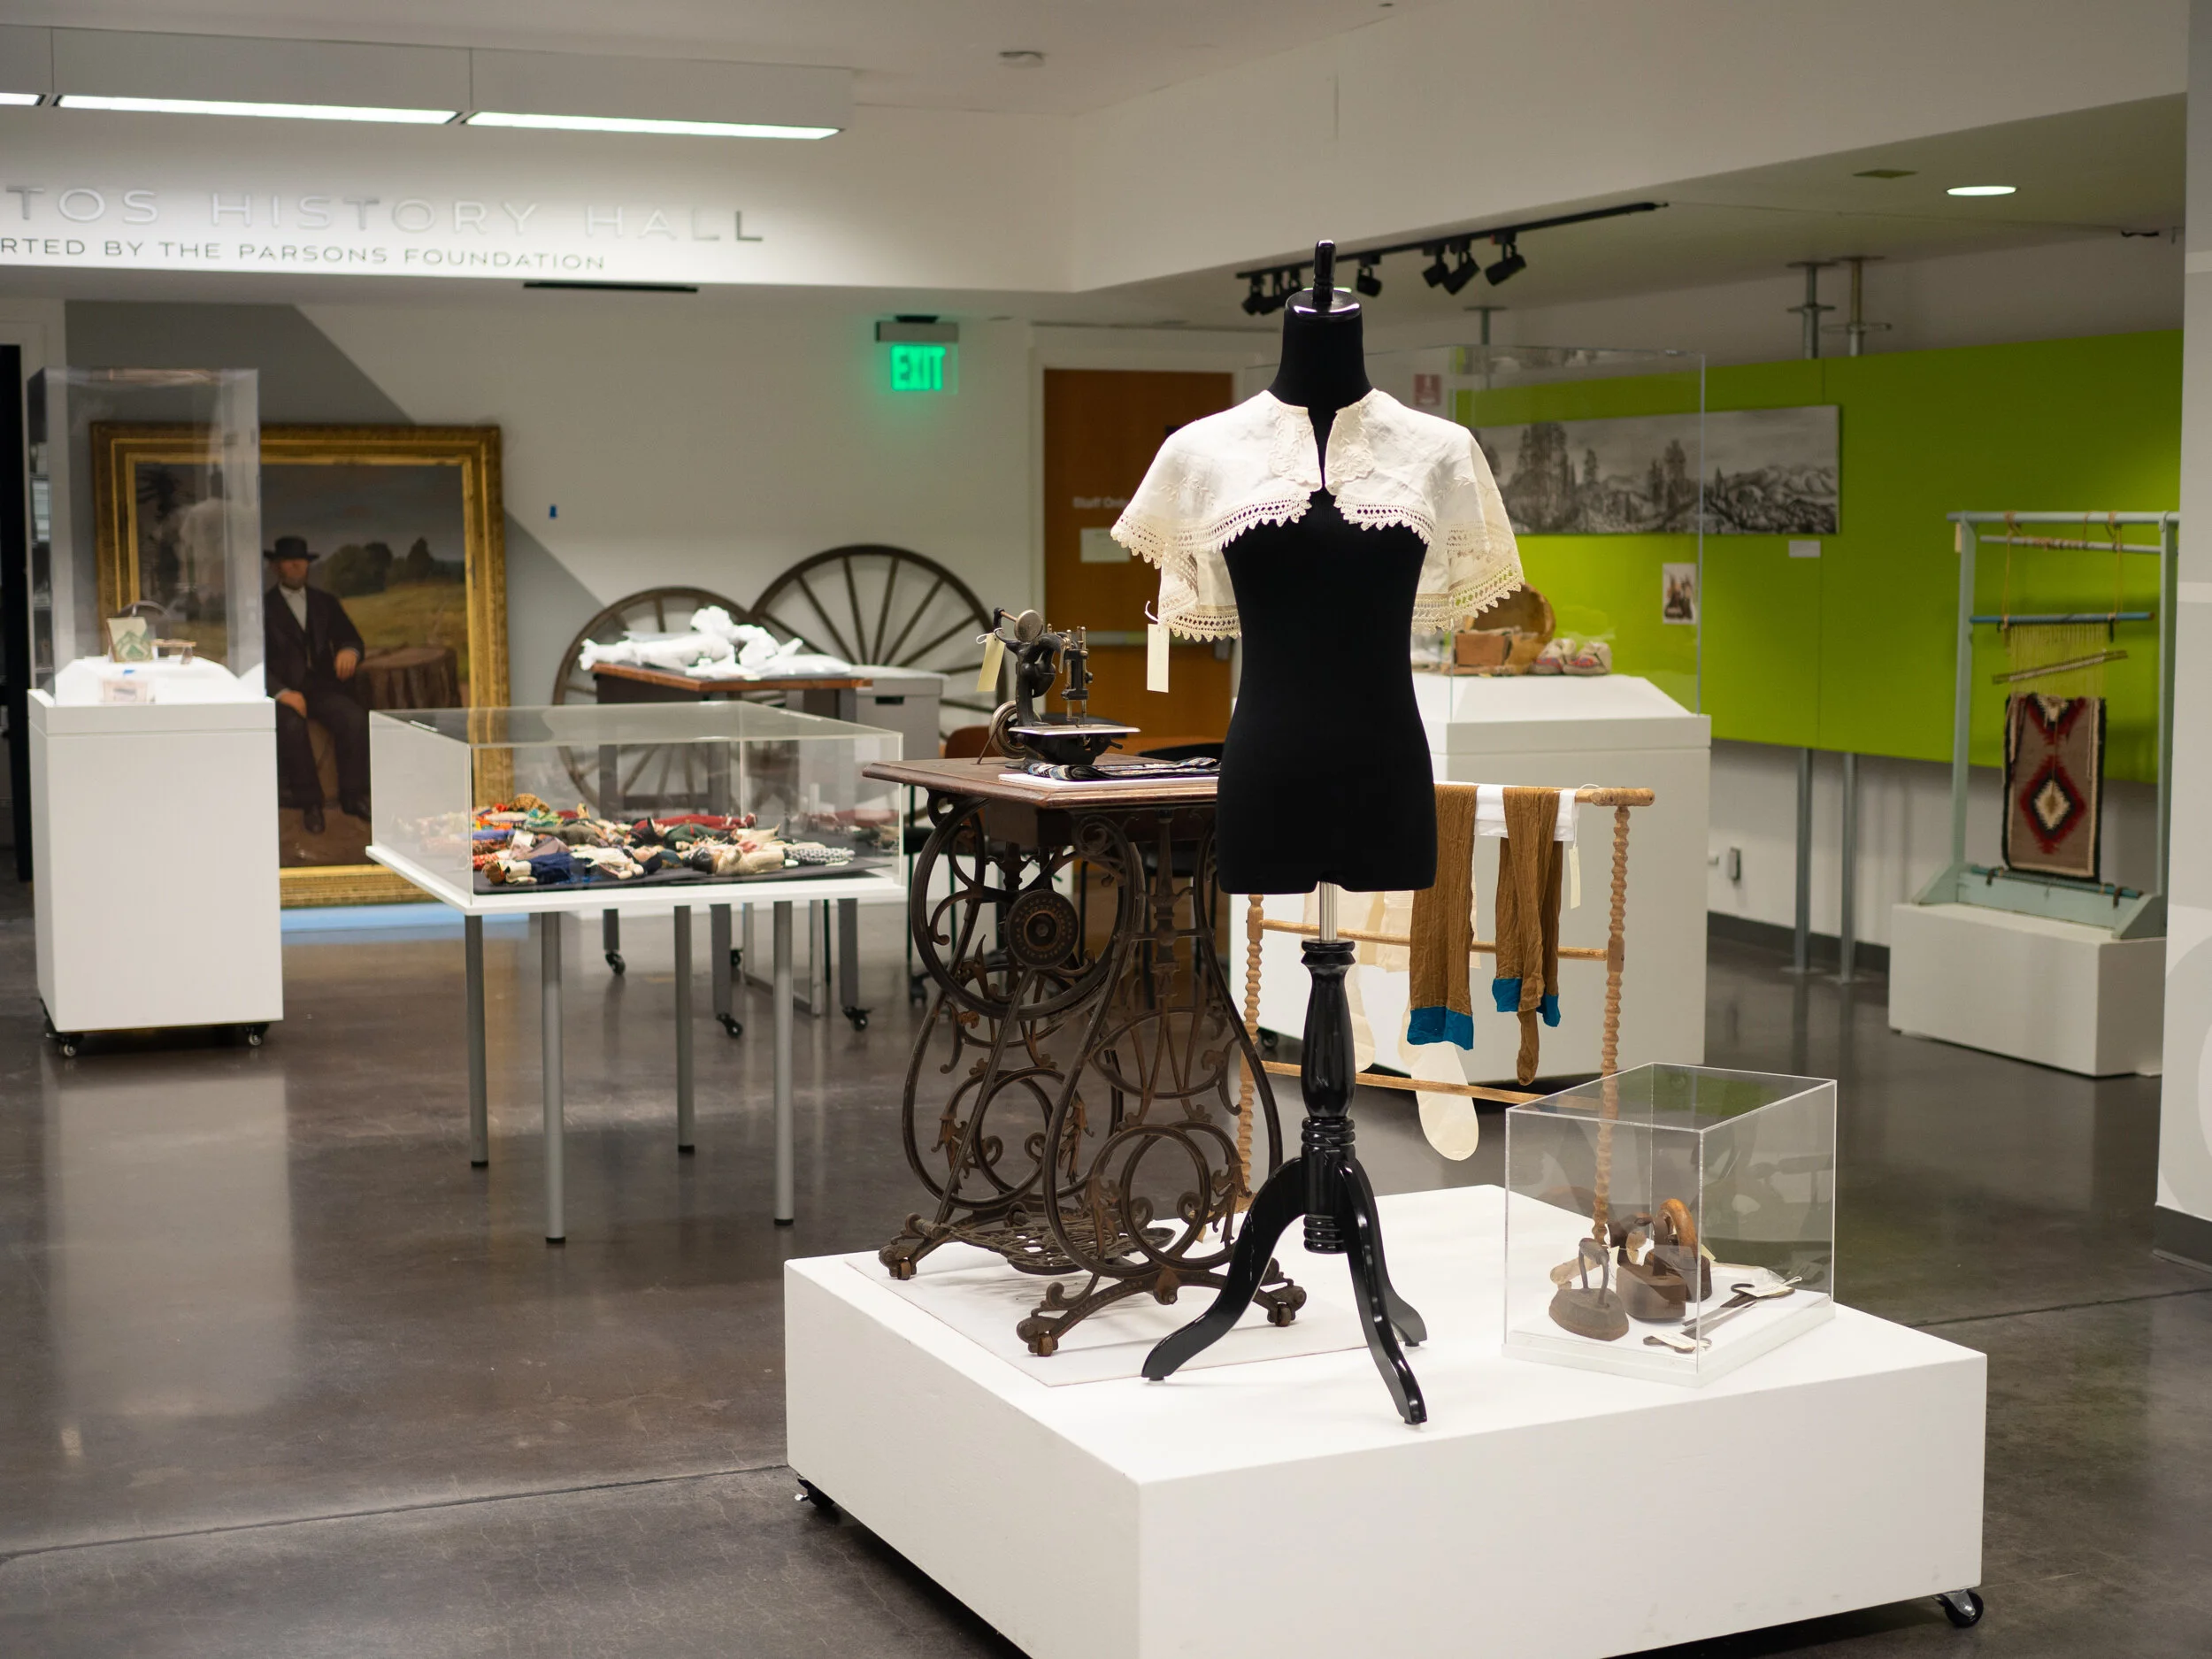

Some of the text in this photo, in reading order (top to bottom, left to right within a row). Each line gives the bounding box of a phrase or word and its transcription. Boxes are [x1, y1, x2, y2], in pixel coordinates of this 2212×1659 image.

[5, 184, 764, 242] TOS HISTORY HALL
[104, 240, 144, 257] BY
[157, 241, 222, 260] THE
[238, 243, 388, 264] PARSONS
[403, 248, 605, 272] FOUNDATION
[890, 344, 947, 391] EXIT
